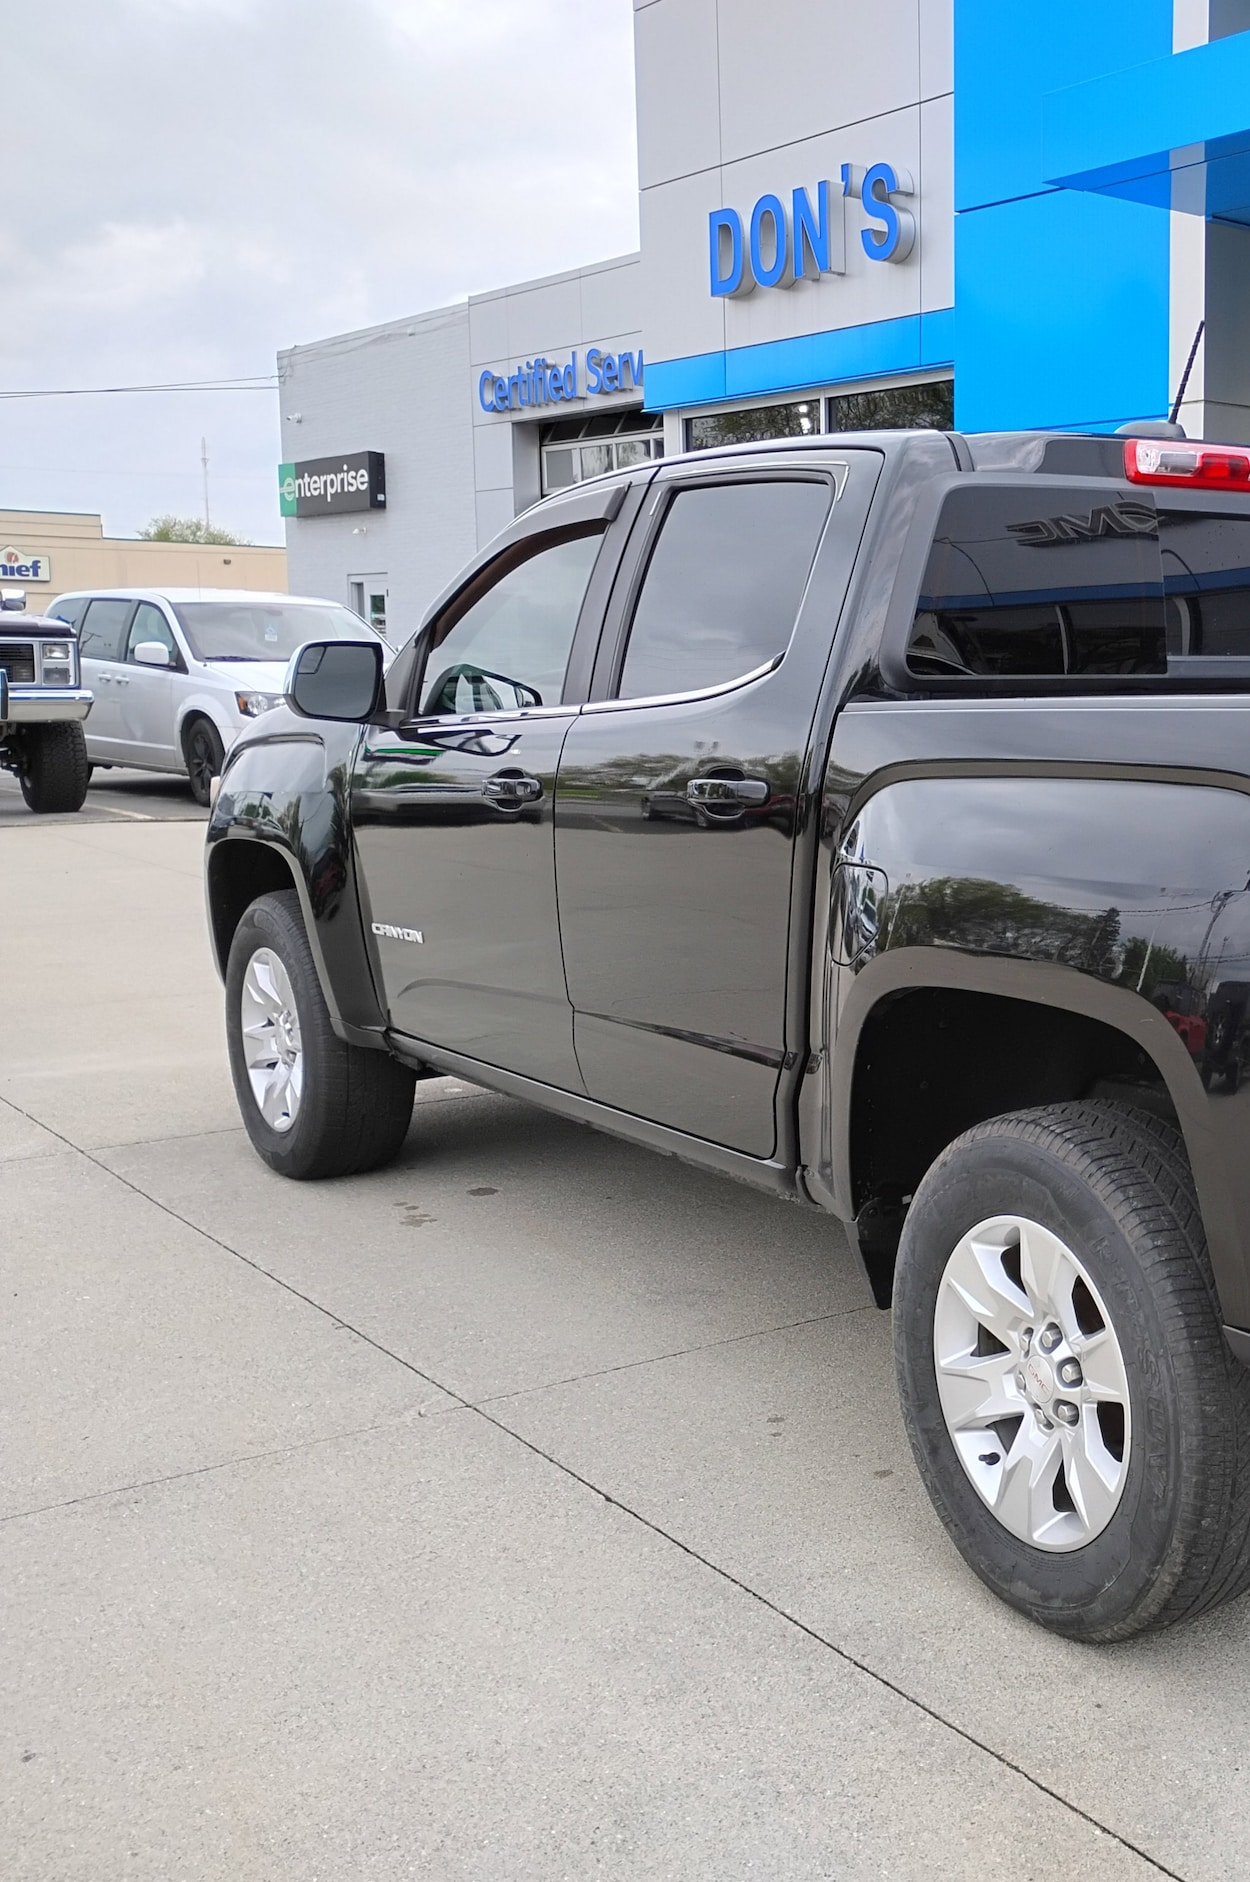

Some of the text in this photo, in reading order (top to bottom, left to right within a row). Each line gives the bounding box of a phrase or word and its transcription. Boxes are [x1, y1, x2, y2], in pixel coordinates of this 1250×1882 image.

[708, 162, 916, 298] DON'S
[479, 351, 577, 412] Certified
[280, 464, 369, 502] enterprise
[371, 922, 424, 944] CANYON
[1028, 1363, 1050, 1396] GMC
